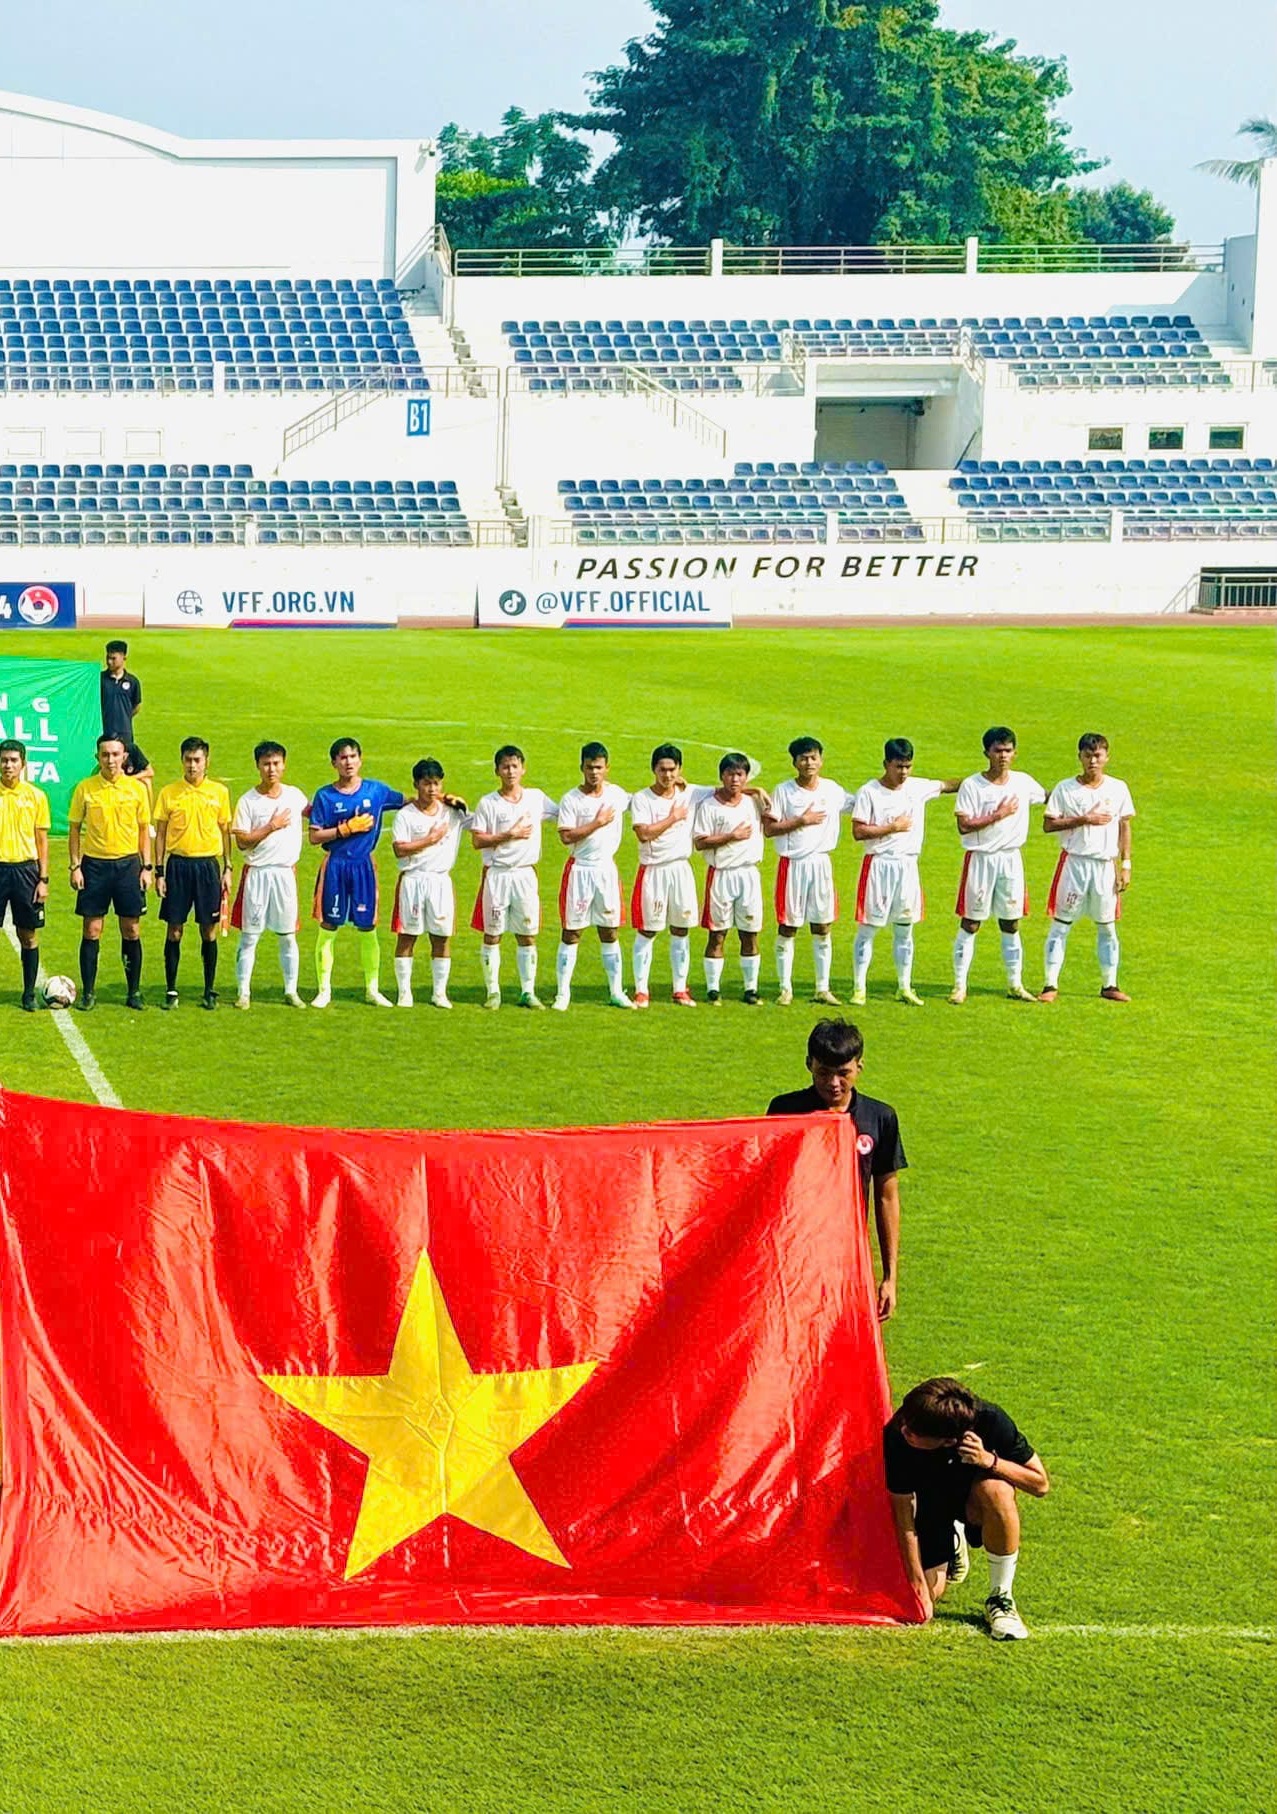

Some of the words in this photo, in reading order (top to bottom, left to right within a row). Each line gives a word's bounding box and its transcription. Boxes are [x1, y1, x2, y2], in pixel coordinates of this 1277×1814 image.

[409, 402, 428, 433] B1
[576, 557, 737, 580] PASSION
[752, 556, 825, 579] FOR
[840, 555, 979, 578] BETTER
[222, 591, 355, 613] VFF.ORG.VN
[535, 589, 711, 615] @VFF.OFFICIAL
